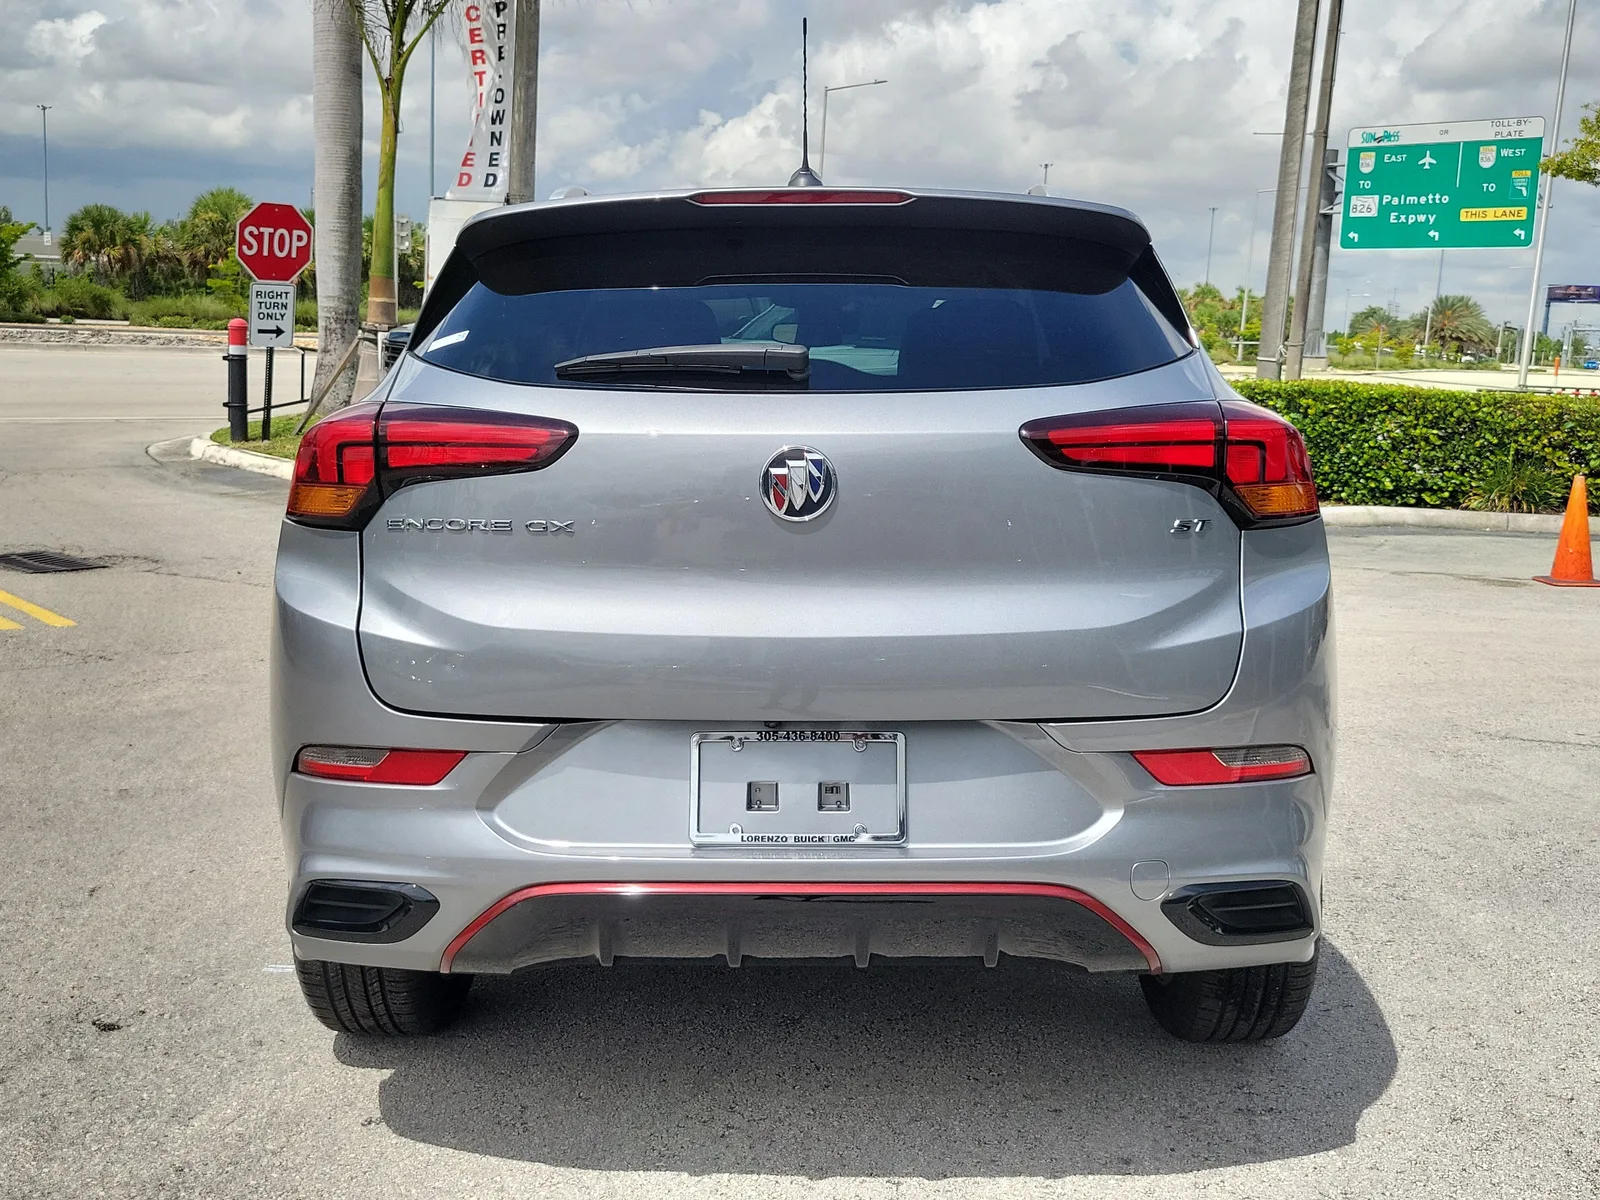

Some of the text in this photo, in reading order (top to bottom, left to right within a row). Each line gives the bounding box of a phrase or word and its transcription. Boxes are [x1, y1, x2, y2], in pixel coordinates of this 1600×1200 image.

[1494, 130, 1524, 138] PLATE
[1500, 148, 1526, 157] WEST
[1384, 154, 1407, 163] EAST
[1359, 180, 1371, 189] TO
[1482, 183, 1496, 192] TO
[1382, 193, 1450, 205] Palmetto
[1351, 204, 1373, 213] 826
[1389, 212, 1436, 225] Expwy
[1464, 209, 1524, 219] THIS LANE
[242, 225, 308, 259] STOP
[256, 290, 290, 300] RIGHT
[257, 301, 288, 310] TURN
[257, 312, 286, 321] ONLY
[386, 518, 575, 533] ENCORE GX
[1169, 518, 1212, 533] ST
[756, 731, 841, 741] 305-436-8400
[740, 835, 856, 843] LORENZO BUICK GMC
